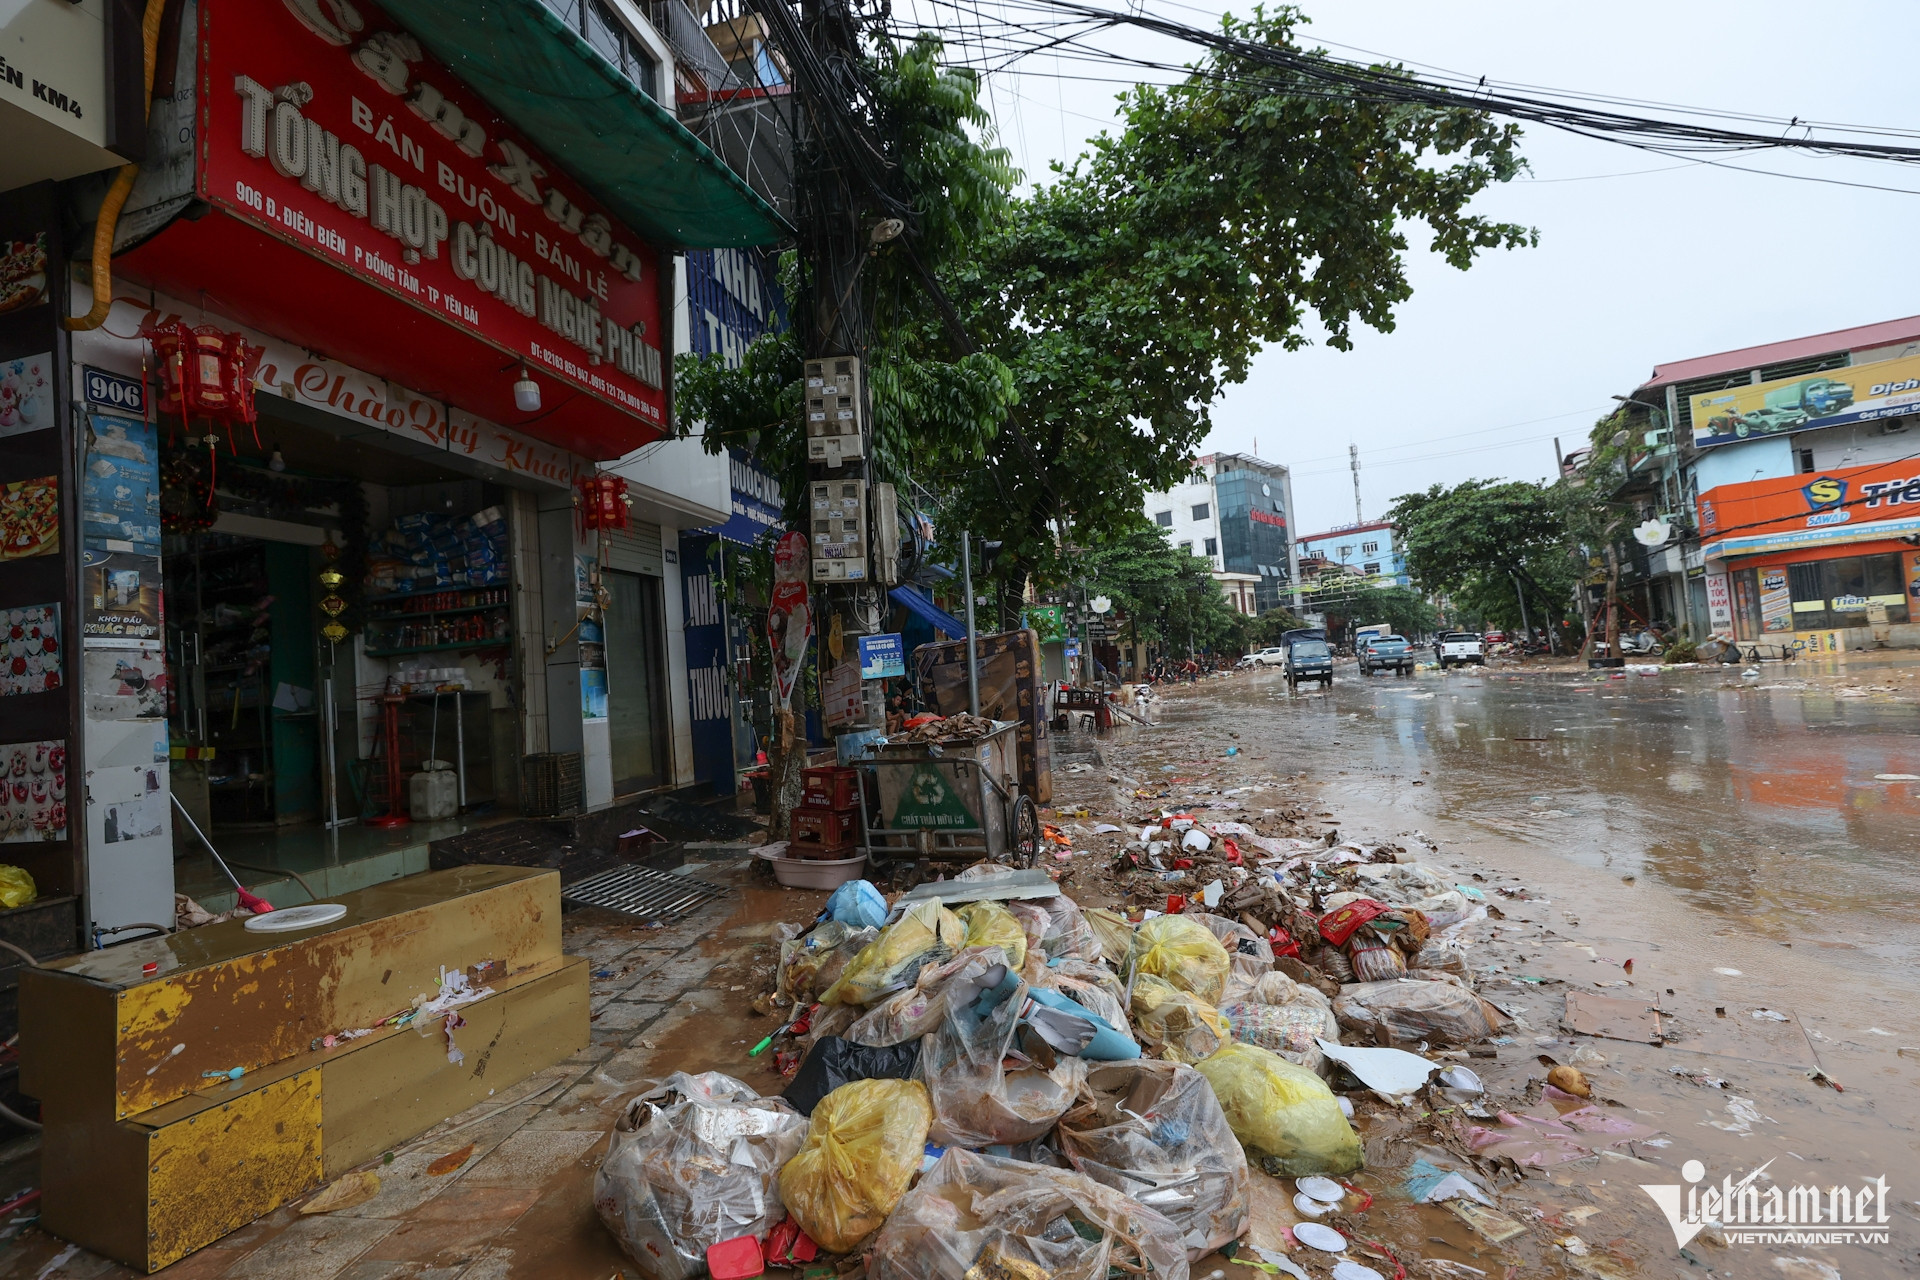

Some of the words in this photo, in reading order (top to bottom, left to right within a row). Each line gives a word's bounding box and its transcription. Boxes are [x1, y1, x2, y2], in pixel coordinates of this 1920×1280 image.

[32, 79, 83, 119] KM4
[352, 95, 425, 174] BÁN
[438, 160, 517, 238] BUÔN
[534, 231, 581, 283] BÁN
[587, 269, 609, 302] LẺ
[487, 138, 643, 282] Xuân
[234, 74, 368, 218] TỔNG
[370, 163, 448, 265] HỢP
[450, 220, 536, 318] CÔNG
[537, 274, 603, 366] NGHỆ
[601, 317, 663, 391] PHẨM
[236, 180, 263, 211] 906
[317, 225, 346, 257] BIÊN
[354, 245, 362, 264] P
[365, 250, 395, 282] ĐỒNG
[398, 267, 420, 295] TÂM
[427, 285, 440, 304] TP
[444, 293, 462, 317] YÊN
[463, 298, 479, 326] BÁI
[713, 247, 764, 323] NHÀ
[91, 376, 140, 409] 906
[531, 341, 542, 359] ĐT:
[564, 360, 577, 377] 853
[606, 381, 616, 397] 121
[1869, 378, 1919, 396] Dịch
[293, 363, 405, 429] Chào
[408, 399, 482, 454] Quý
[1807, 511, 1850, 528] SAWAD
[687, 564, 720, 627] NHÀ
[1710, 599, 1728, 608] NAM
[84, 622, 124, 635] KHÁC
[125, 623, 157, 638] BIỆT
[690, 648, 730, 721] THUỐC
[901, 811, 919, 825] CHẤT
[919, 811, 936, 825] THẢI
